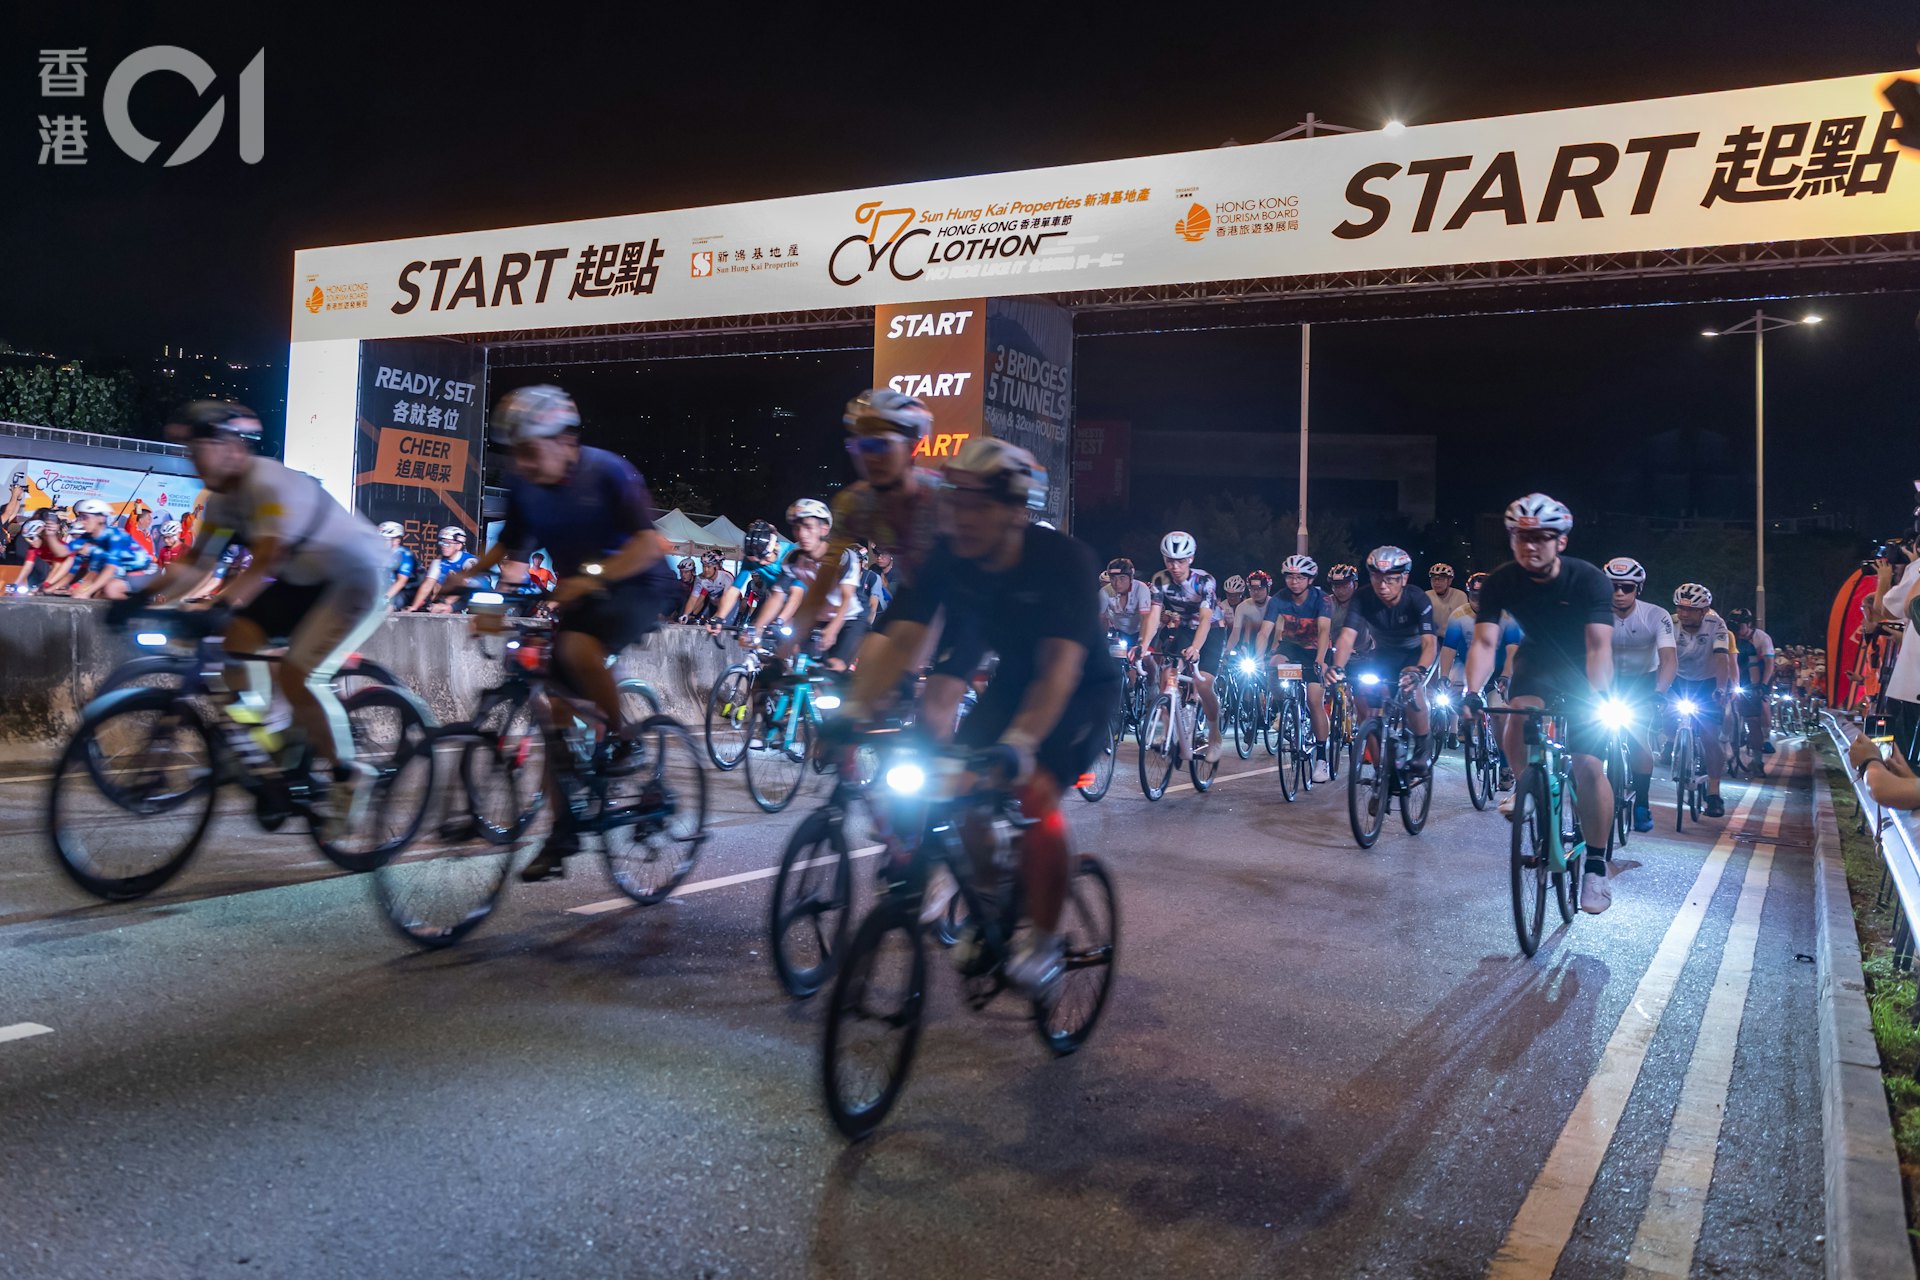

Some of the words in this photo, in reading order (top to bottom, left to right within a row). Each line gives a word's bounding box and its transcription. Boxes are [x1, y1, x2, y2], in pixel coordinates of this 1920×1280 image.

[1331, 131, 1700, 240] START
[1700, 110, 1904, 209] 起點
[919, 210, 943, 223] Sun
[946, 206, 982, 222] Hung
[985, 203, 1008, 217] Kai
[1010, 196, 1082, 214] Properties
[1083, 187, 1151, 207] 新鴻基地產
[1216, 200, 1256, 213] HONG
[1259, 195, 1299, 210] KONG
[1216, 212, 1260, 224] TOURISM
[1262, 208, 1299, 220] BOARD
[937, 222, 976, 238] HONG
[978, 219, 1018, 235] KONG
[1020, 215, 1073, 230] 香港單車節
[1216, 220, 1299, 237] 香港旅遊發展局
[390, 248, 568, 315] START
[568, 238, 666, 302] 起點
[716, 265, 729, 274] Sun
[731, 264, 749, 275] Hung
[751, 262, 763, 272] Kai
[764, 259, 799, 271] Properties
[887, 310, 973, 339] START
[994, 344, 1006, 372] 3
[1007, 348, 1069, 393] BRIDGES
[374, 366, 441, 401] READY,
[443, 380, 476, 407] SET,
[888, 372, 971, 397] START
[987, 371, 1000, 401] 5
[1001, 375, 1067, 420] TUNNELS
[392, 399, 460, 431] 各就各位
[1006, 411, 1014, 428] &
[1035, 421, 1066, 441] ROUTES
[399, 436, 451, 460] CHEER
[911, 433, 969, 457] ART
[395, 458, 452, 484] 追風喝采
[403, 519, 439, 543] 只在
